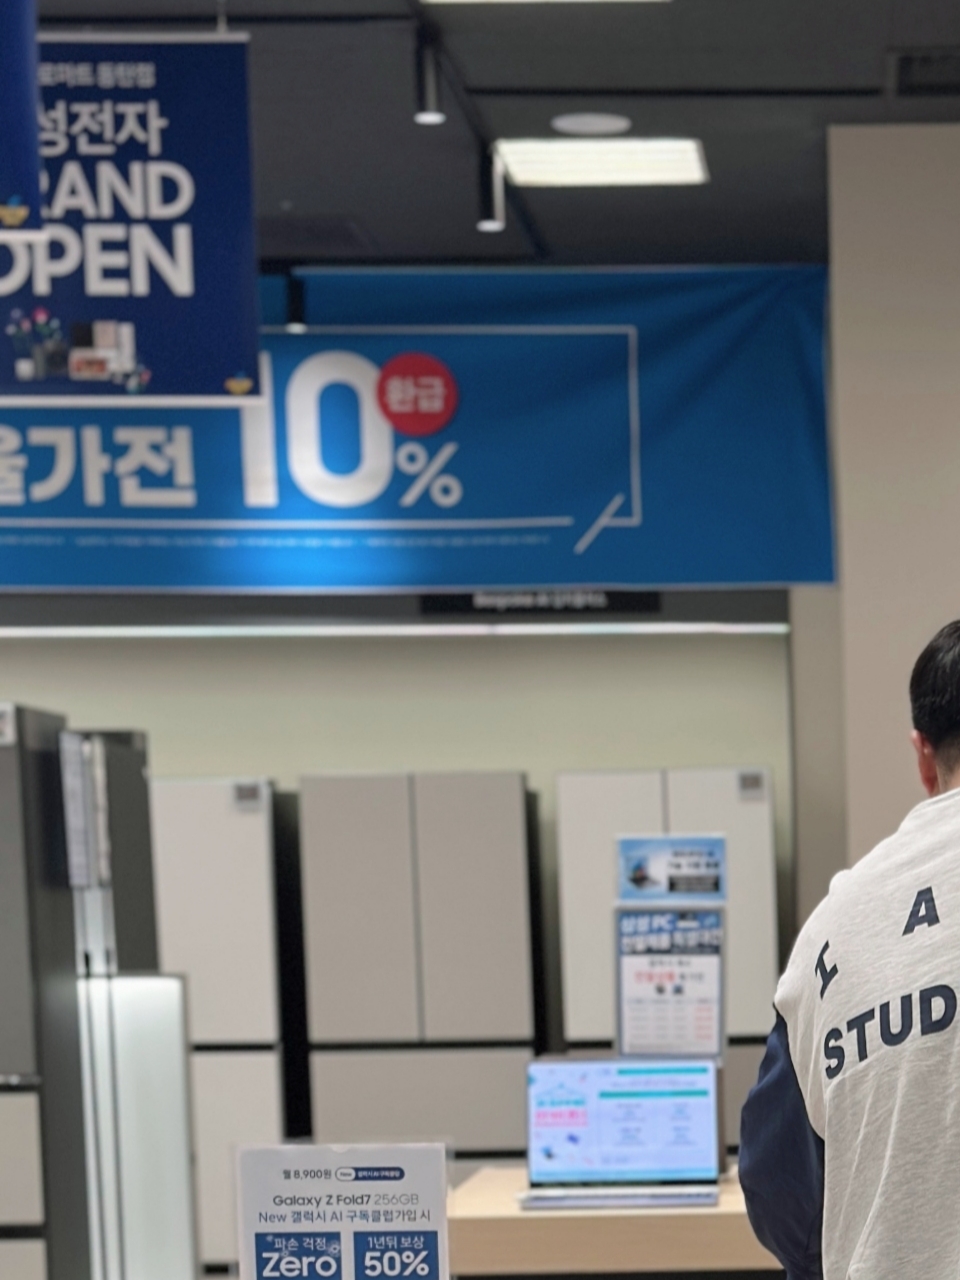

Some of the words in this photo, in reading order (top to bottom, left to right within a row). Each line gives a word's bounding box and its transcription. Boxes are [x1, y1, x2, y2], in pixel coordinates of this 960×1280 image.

[39, 160, 195, 220] AND
[294, 1168, 332, 1181] 8,900원
[272, 1195, 322, 1208] Galaxy
[325, 1195, 334, 1206] Z
[336, 1194, 371, 1206] Fold7
[374, 1193, 419, 1206] 256GB
[259, 1212, 287, 1223] New
[291, 1210, 326, 1223] 갤럭시
[330, 1211, 342, 1222] AI
[420, 1210, 431, 1222] 시
[274, 1238, 299, 1250] 파손
[303, 1237, 326, 1250] 걱정
[368, 1237, 397, 1250] 1년뒤
[400, 1236, 424, 1249] 보상
[262, 1251, 337, 1278] Zero
[364, 1250, 429, 1277] 50%
